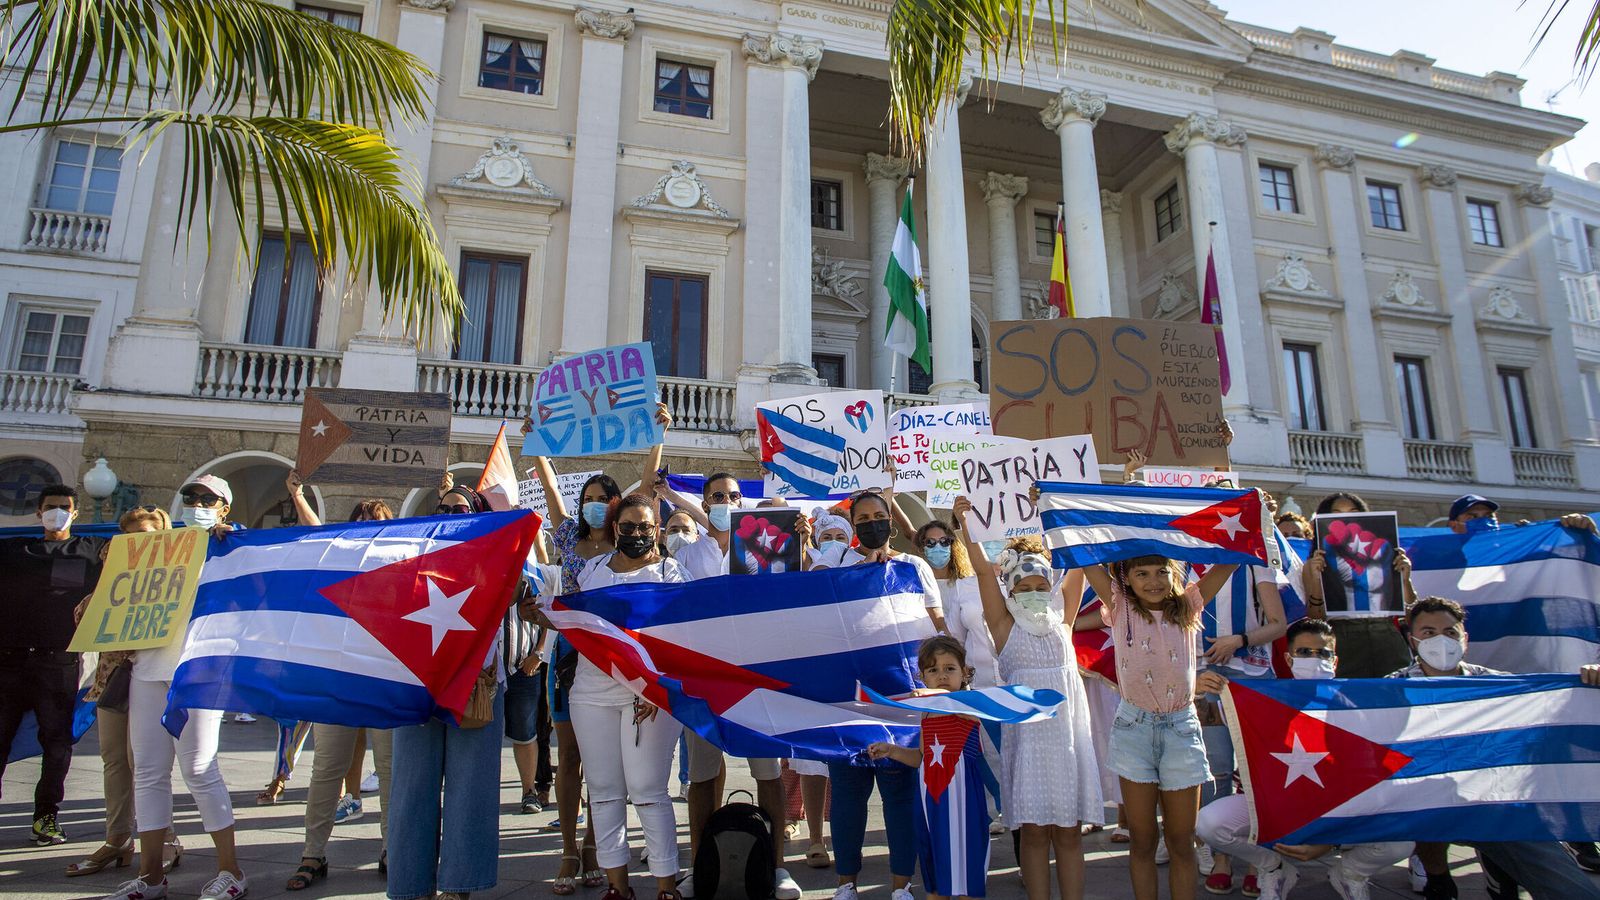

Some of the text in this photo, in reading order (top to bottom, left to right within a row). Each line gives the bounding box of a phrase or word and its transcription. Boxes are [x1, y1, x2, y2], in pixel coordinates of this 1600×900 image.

[1161, 328, 1180, 341] EL
[1160, 343, 1216, 359] PUEBLO
[995, 325, 1153, 400] SOS
[1156, 375, 1218, 388] MURIENDO
[580, 387, 599, 416] Y
[1181, 391, 1212, 405] BAJO
[1207, 412, 1220, 423] LA
[387, 428, 401, 443] Y
[890, 435, 909, 451] EL
[931, 440, 976, 455] LUCHO
[891, 454, 911, 465] NO
[930, 459, 958, 474] QUE
[1073, 443, 1087, 478] Y
[895, 469, 926, 481] FUERA
[1148, 472, 1193, 487] LUCHO
[935, 479, 961, 491] NOS
[110, 565, 187, 607] CUBA
